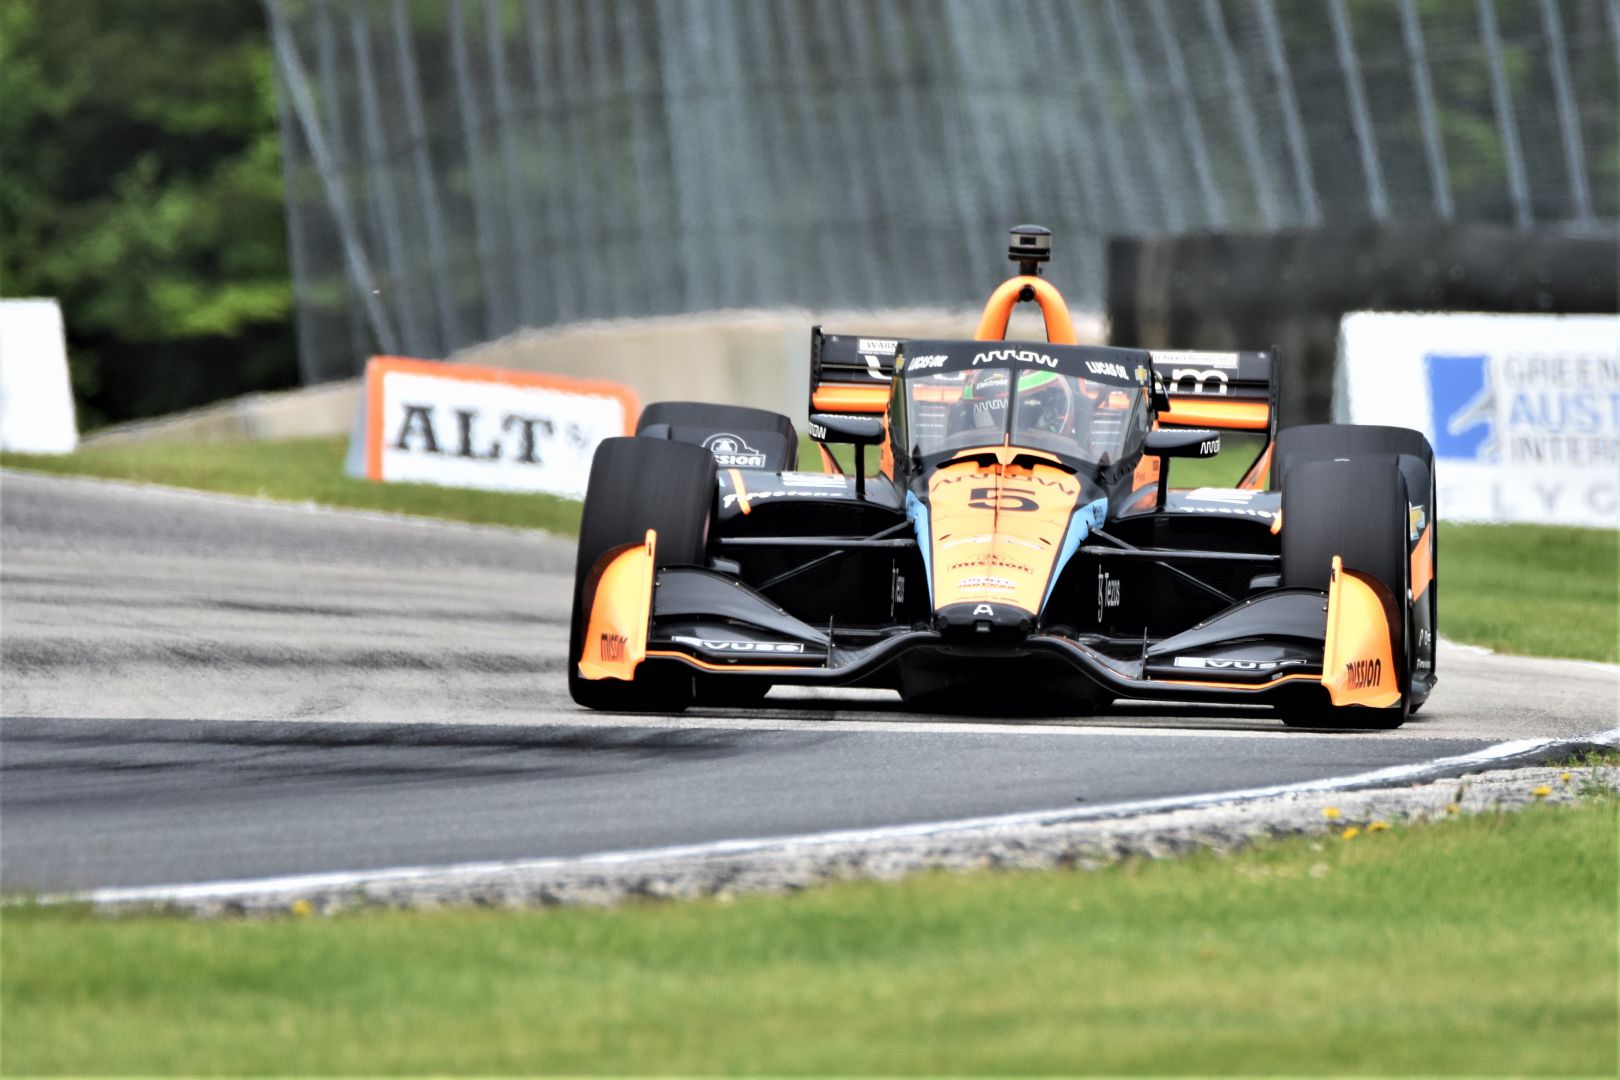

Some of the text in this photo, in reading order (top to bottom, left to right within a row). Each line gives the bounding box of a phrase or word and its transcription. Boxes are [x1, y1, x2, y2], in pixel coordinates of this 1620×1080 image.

[972, 350, 1058, 368] ARROW
[1085, 361, 1129, 380] LUCAS OIL
[391, 404, 554, 464] ALT
[967, 487, 1040, 512] 5
[1347, 657, 1382, 689] mission
